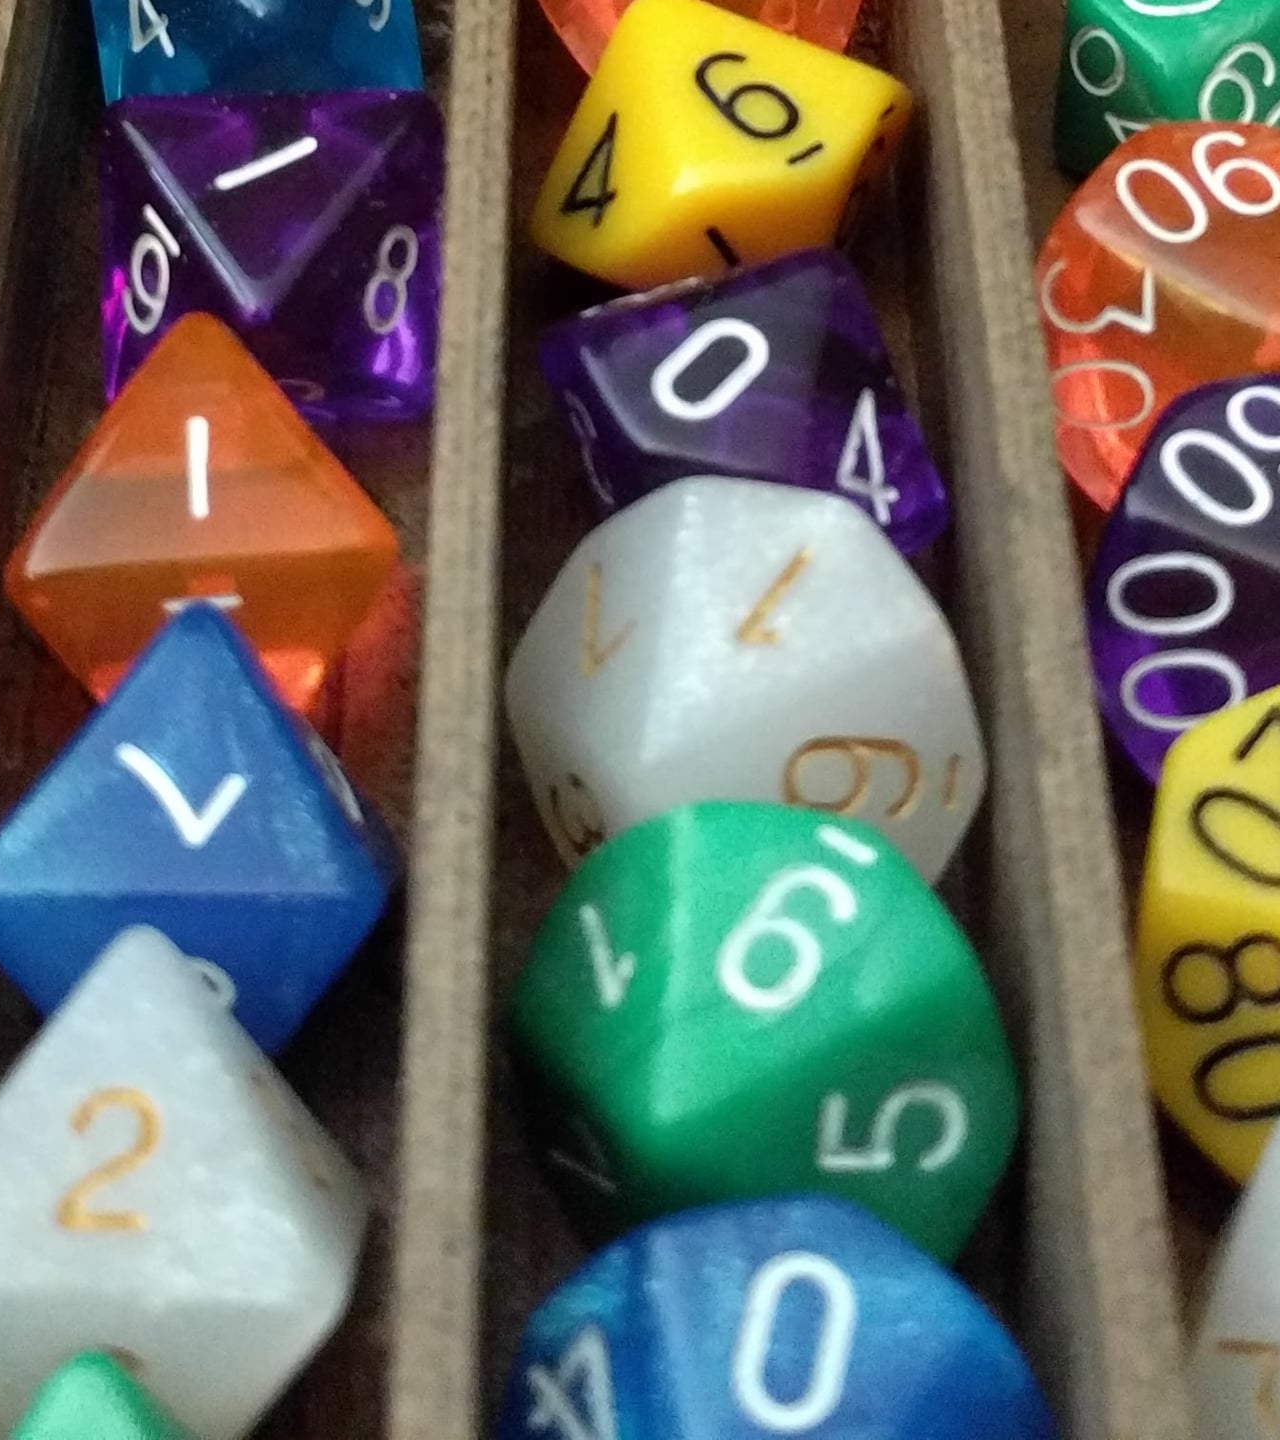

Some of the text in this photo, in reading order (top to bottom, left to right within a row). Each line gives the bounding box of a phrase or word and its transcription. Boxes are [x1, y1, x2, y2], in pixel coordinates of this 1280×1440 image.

[559, 112, 618, 229] 4
[363, 224, 419, 334] 8
[650, 317, 770, 422] 0
[185, 415, 210, 520] 1
[837, 389, 900, 526] 4
[1107, 551, 1248, 730] 00
[56, 1084, 162, 1232] 2
[818, 1078, 968, 1174] 5
[733, 1251, 857, 1432] 0
